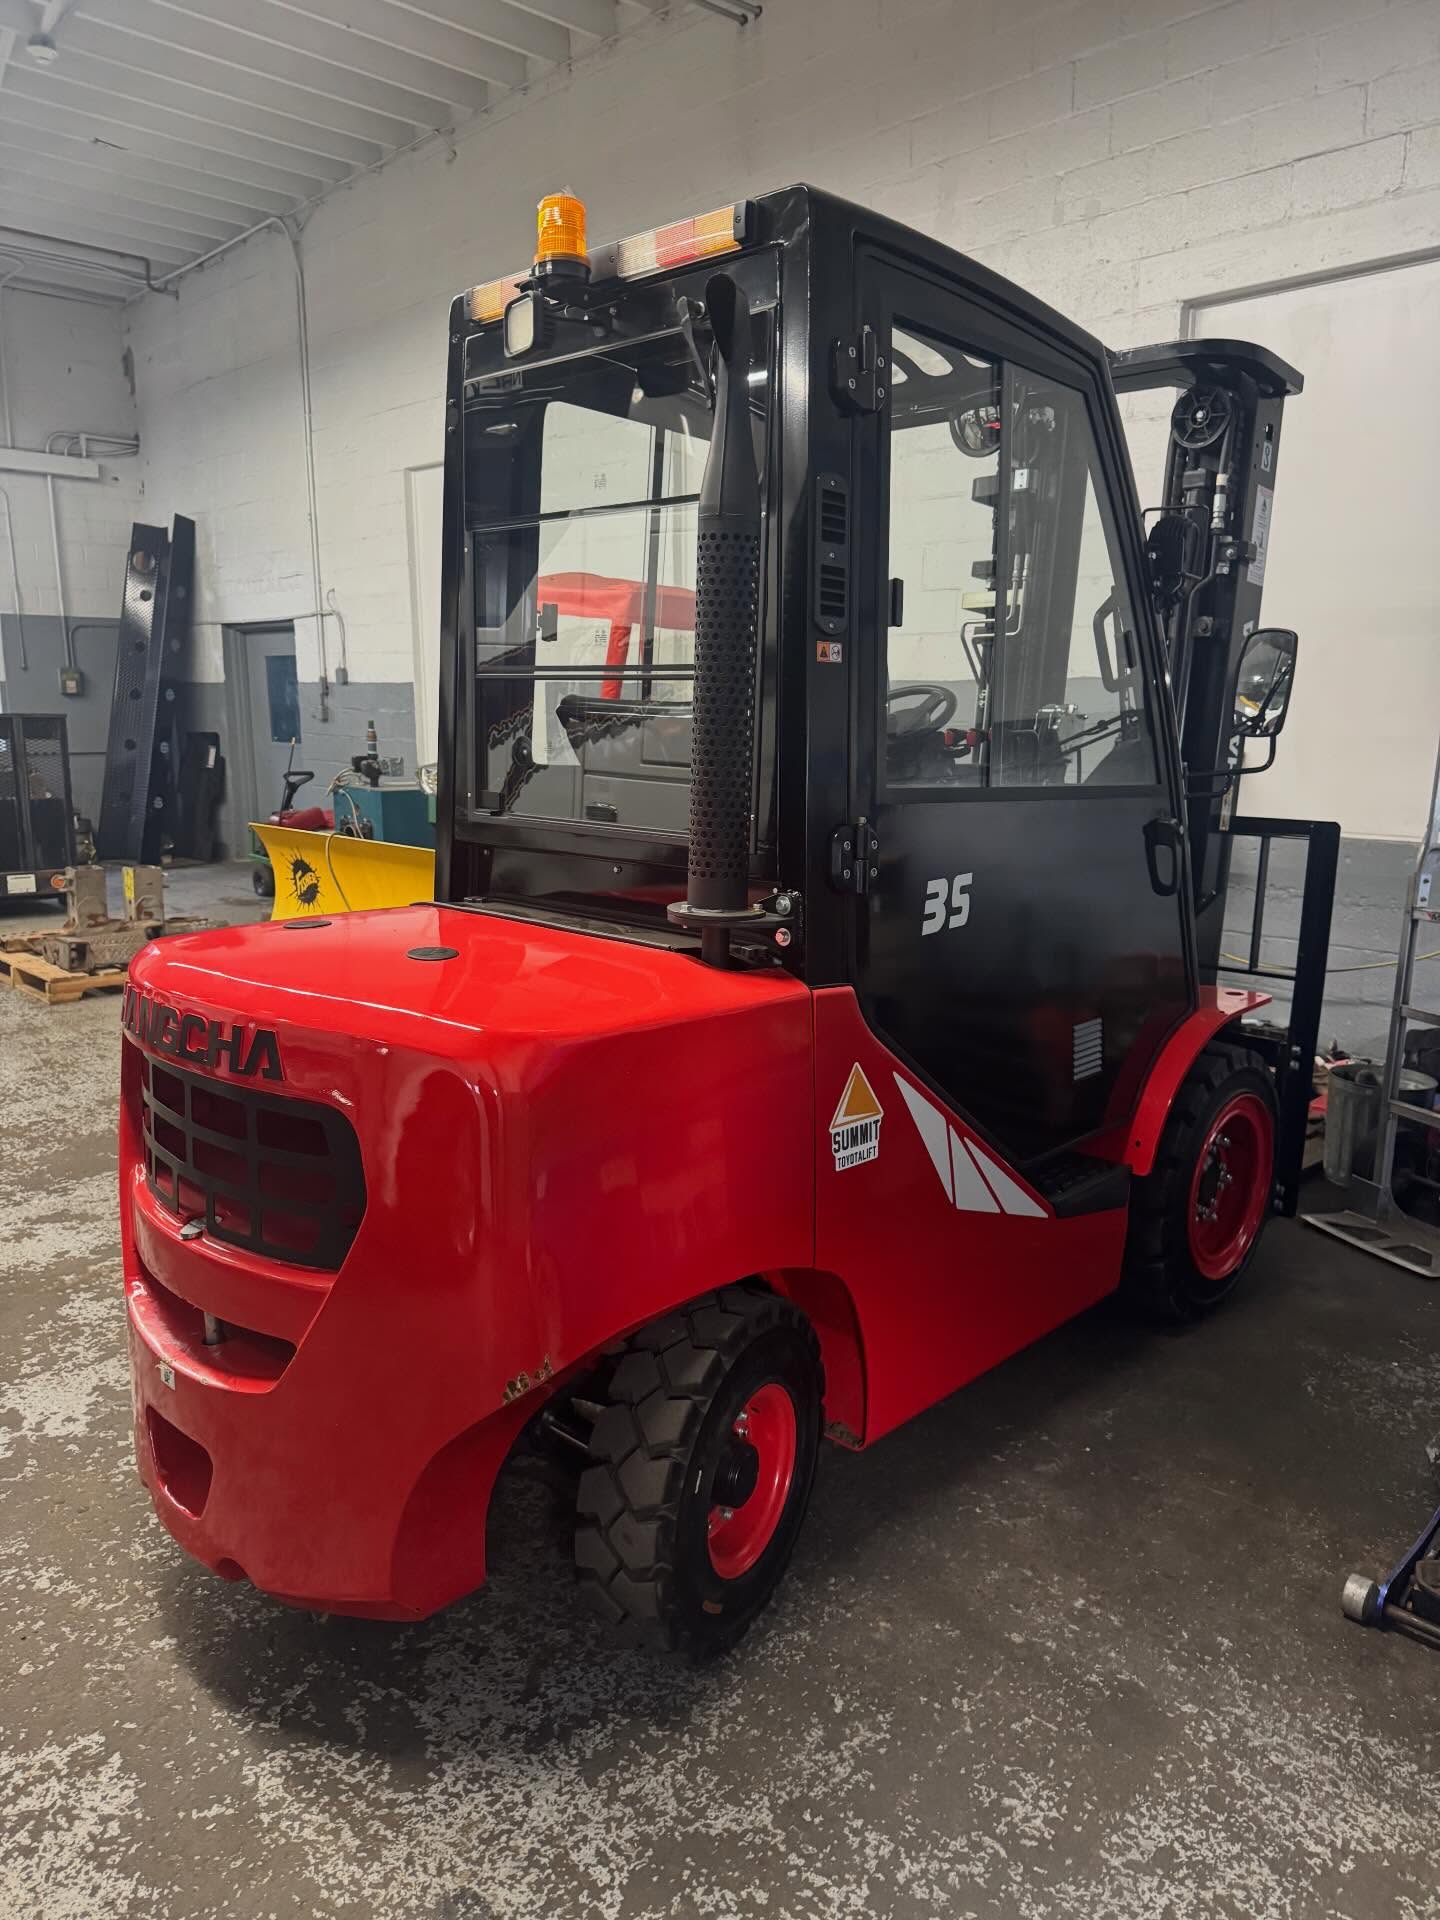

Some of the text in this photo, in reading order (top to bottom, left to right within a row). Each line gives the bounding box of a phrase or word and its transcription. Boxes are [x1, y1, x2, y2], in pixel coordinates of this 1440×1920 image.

[922, 873, 973, 936] 35
[833, 1119, 880, 1153] SUMMIT
[838, 1146, 877, 1169] TOYOTALIFT
